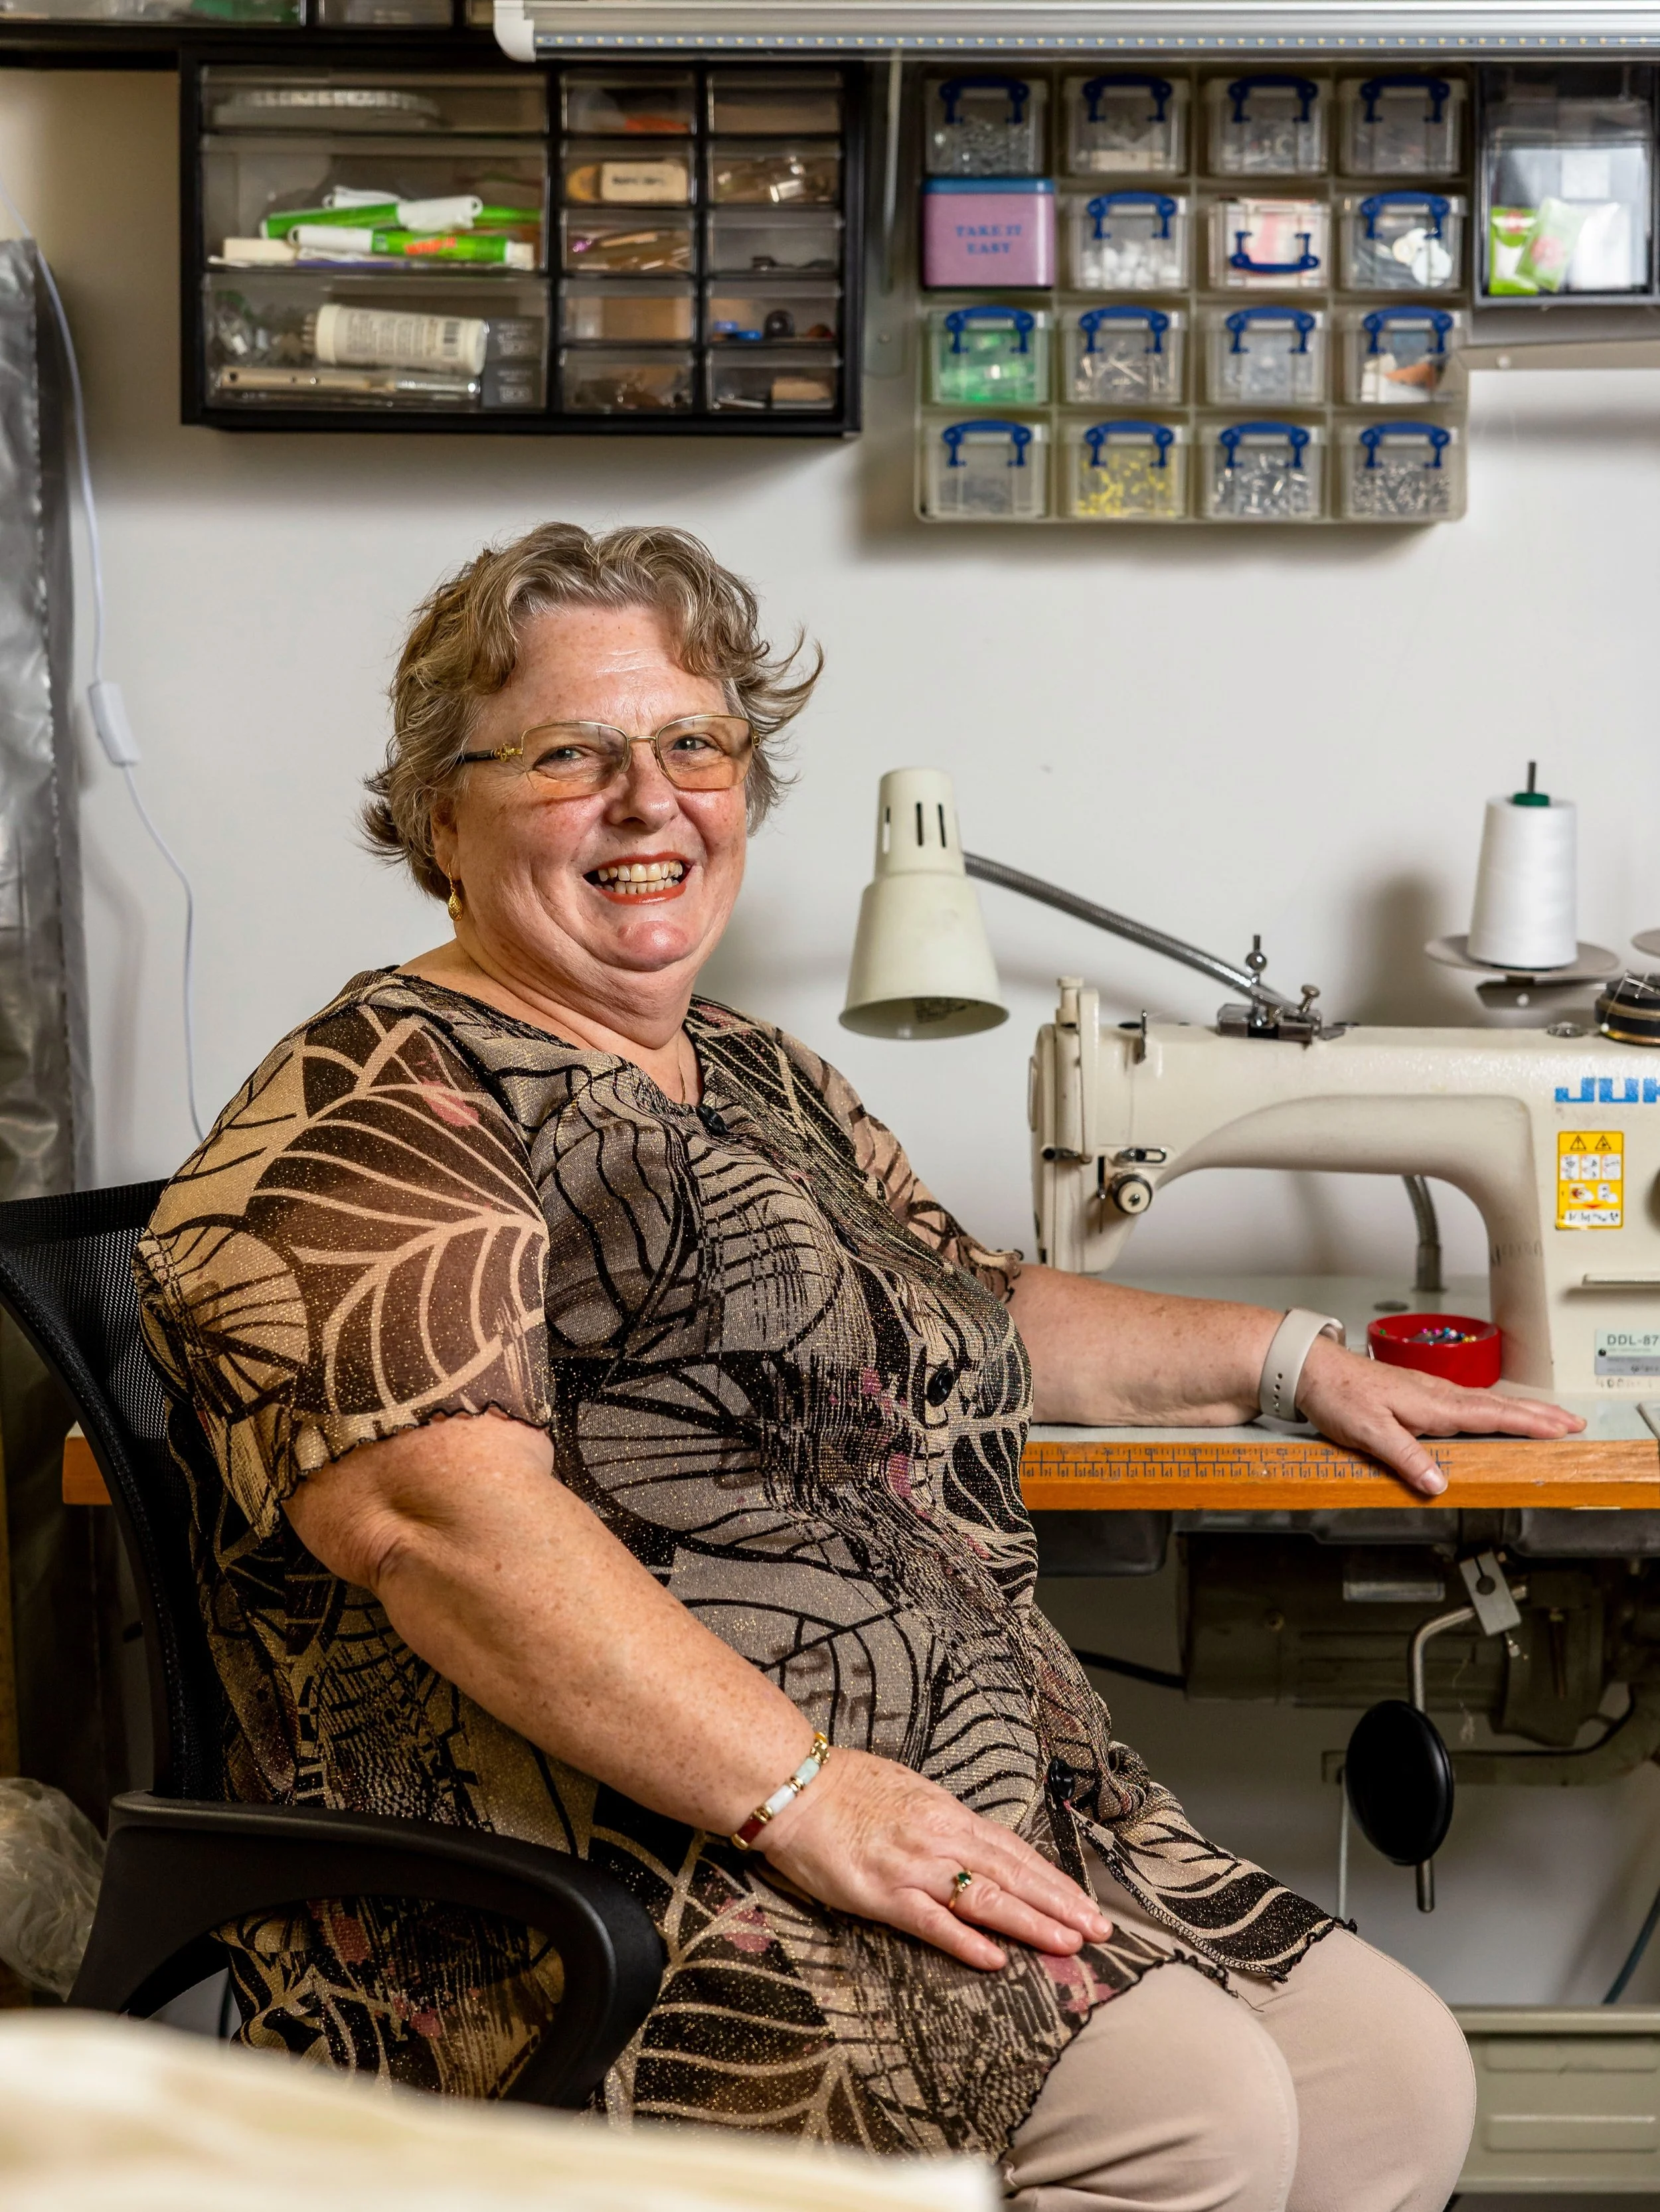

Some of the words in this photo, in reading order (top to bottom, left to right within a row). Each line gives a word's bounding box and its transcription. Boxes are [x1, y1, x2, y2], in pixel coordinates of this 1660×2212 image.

[955, 225, 1001, 237] TAKE
[1005, 224, 1022, 236] IT
[966, 242, 1011, 254] EASY
